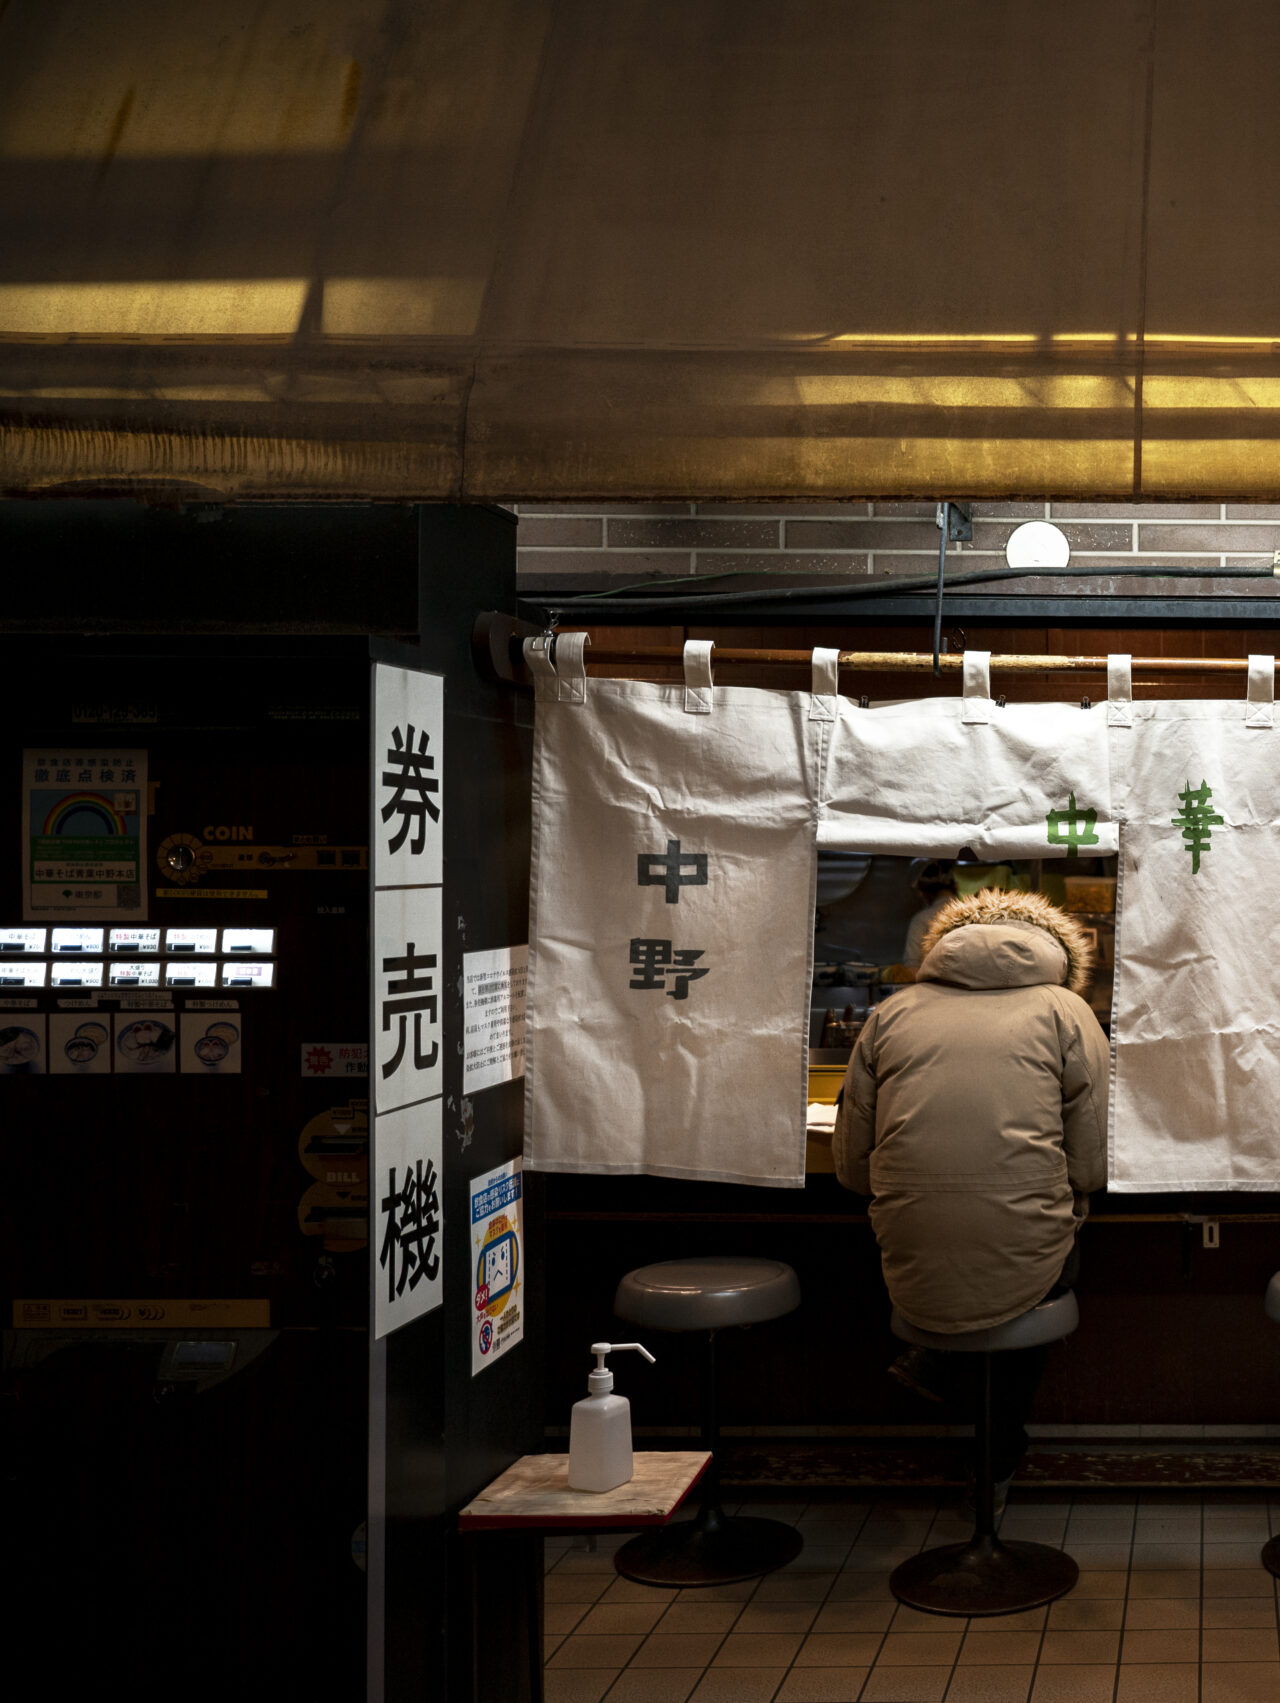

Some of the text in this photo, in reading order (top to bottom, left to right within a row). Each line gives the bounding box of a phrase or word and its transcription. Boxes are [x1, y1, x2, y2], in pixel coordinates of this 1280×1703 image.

[34, 768, 137, 784] 徹底点検済
[202, 825, 254, 842] COIN
[629, 839, 711, 1001] 中野
[115, 932, 158, 941] 特製中華そば
[380, 723, 441, 1303] 券売機
[326, 1171, 361, 1183] BILL
